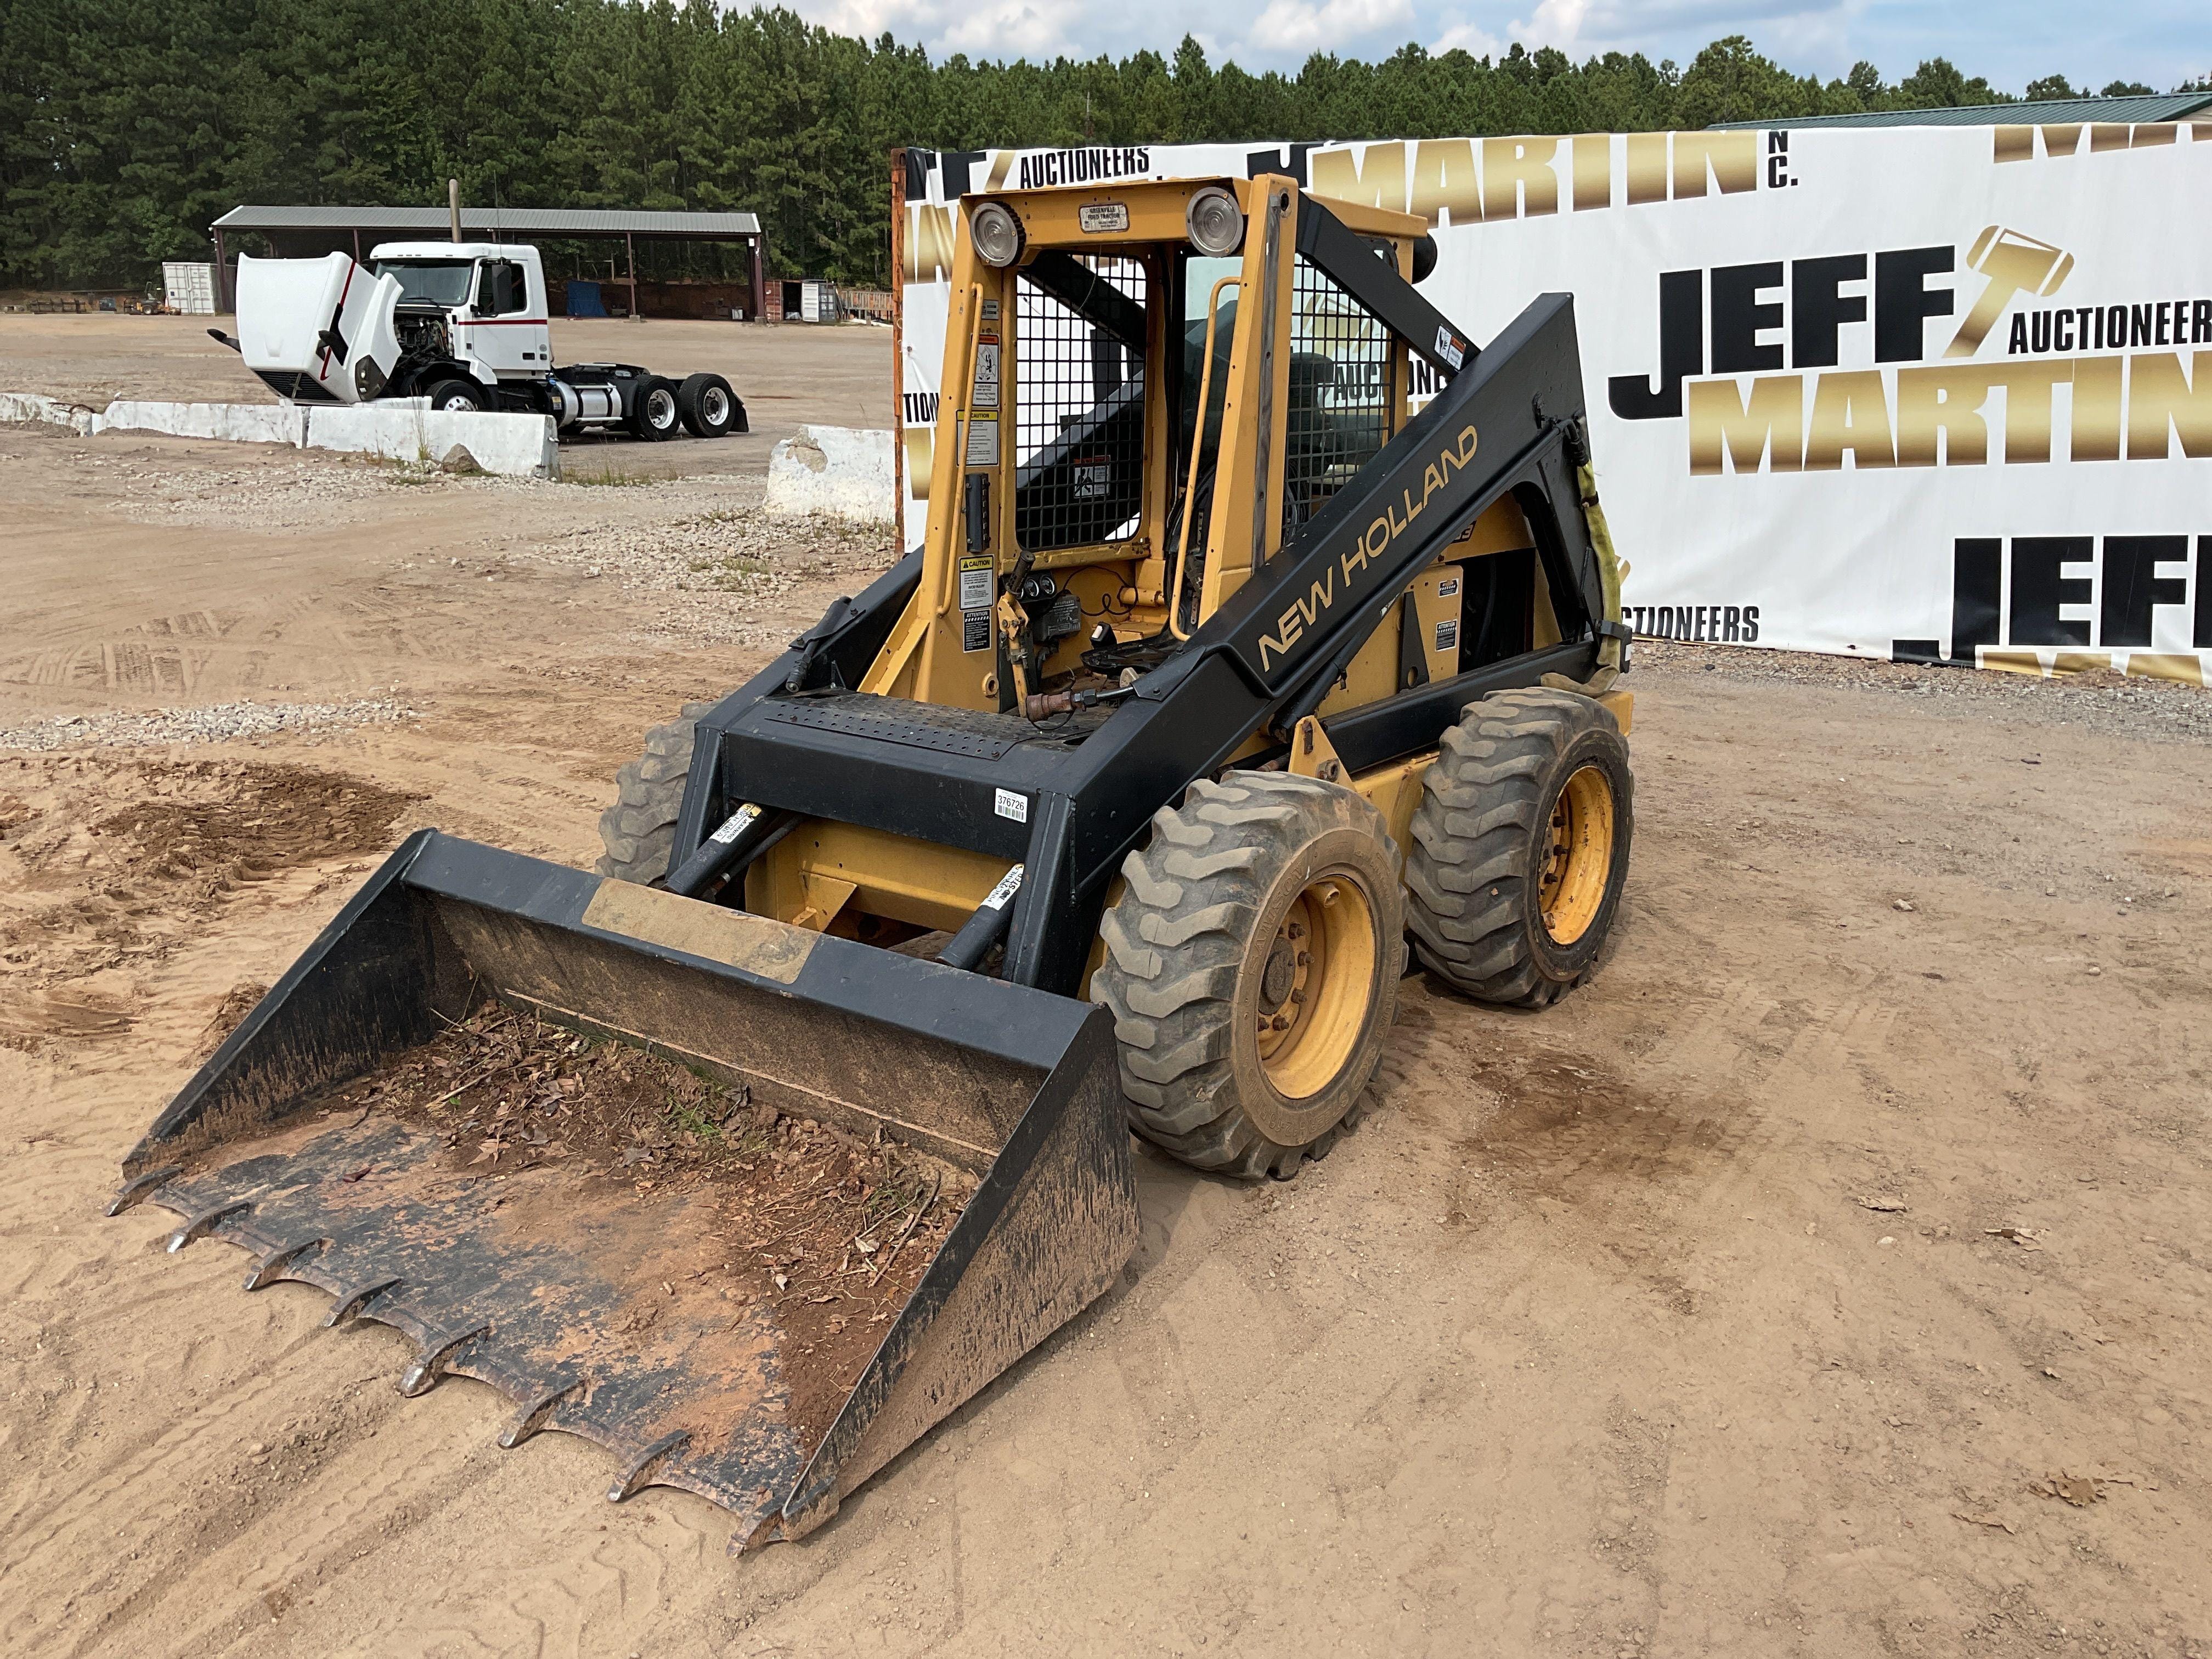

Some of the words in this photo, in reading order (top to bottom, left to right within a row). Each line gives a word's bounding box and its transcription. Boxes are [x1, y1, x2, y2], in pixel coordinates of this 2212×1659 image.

[1020, 147, 1150, 189] AUCTIONEERS
[1608, 245, 1955, 420] JEFF
[1689, 349, 2212, 476] MARTIN
[1258, 566, 1333, 673] NEW
[1340, 425, 1478, 588] HOLLAND
[1892, 535, 2212, 668] JEF
[727, 818, 748, 839] WARNING
[997, 795, 1024, 811] 376726
[1248, 862, 1303, 975] SAMSON
